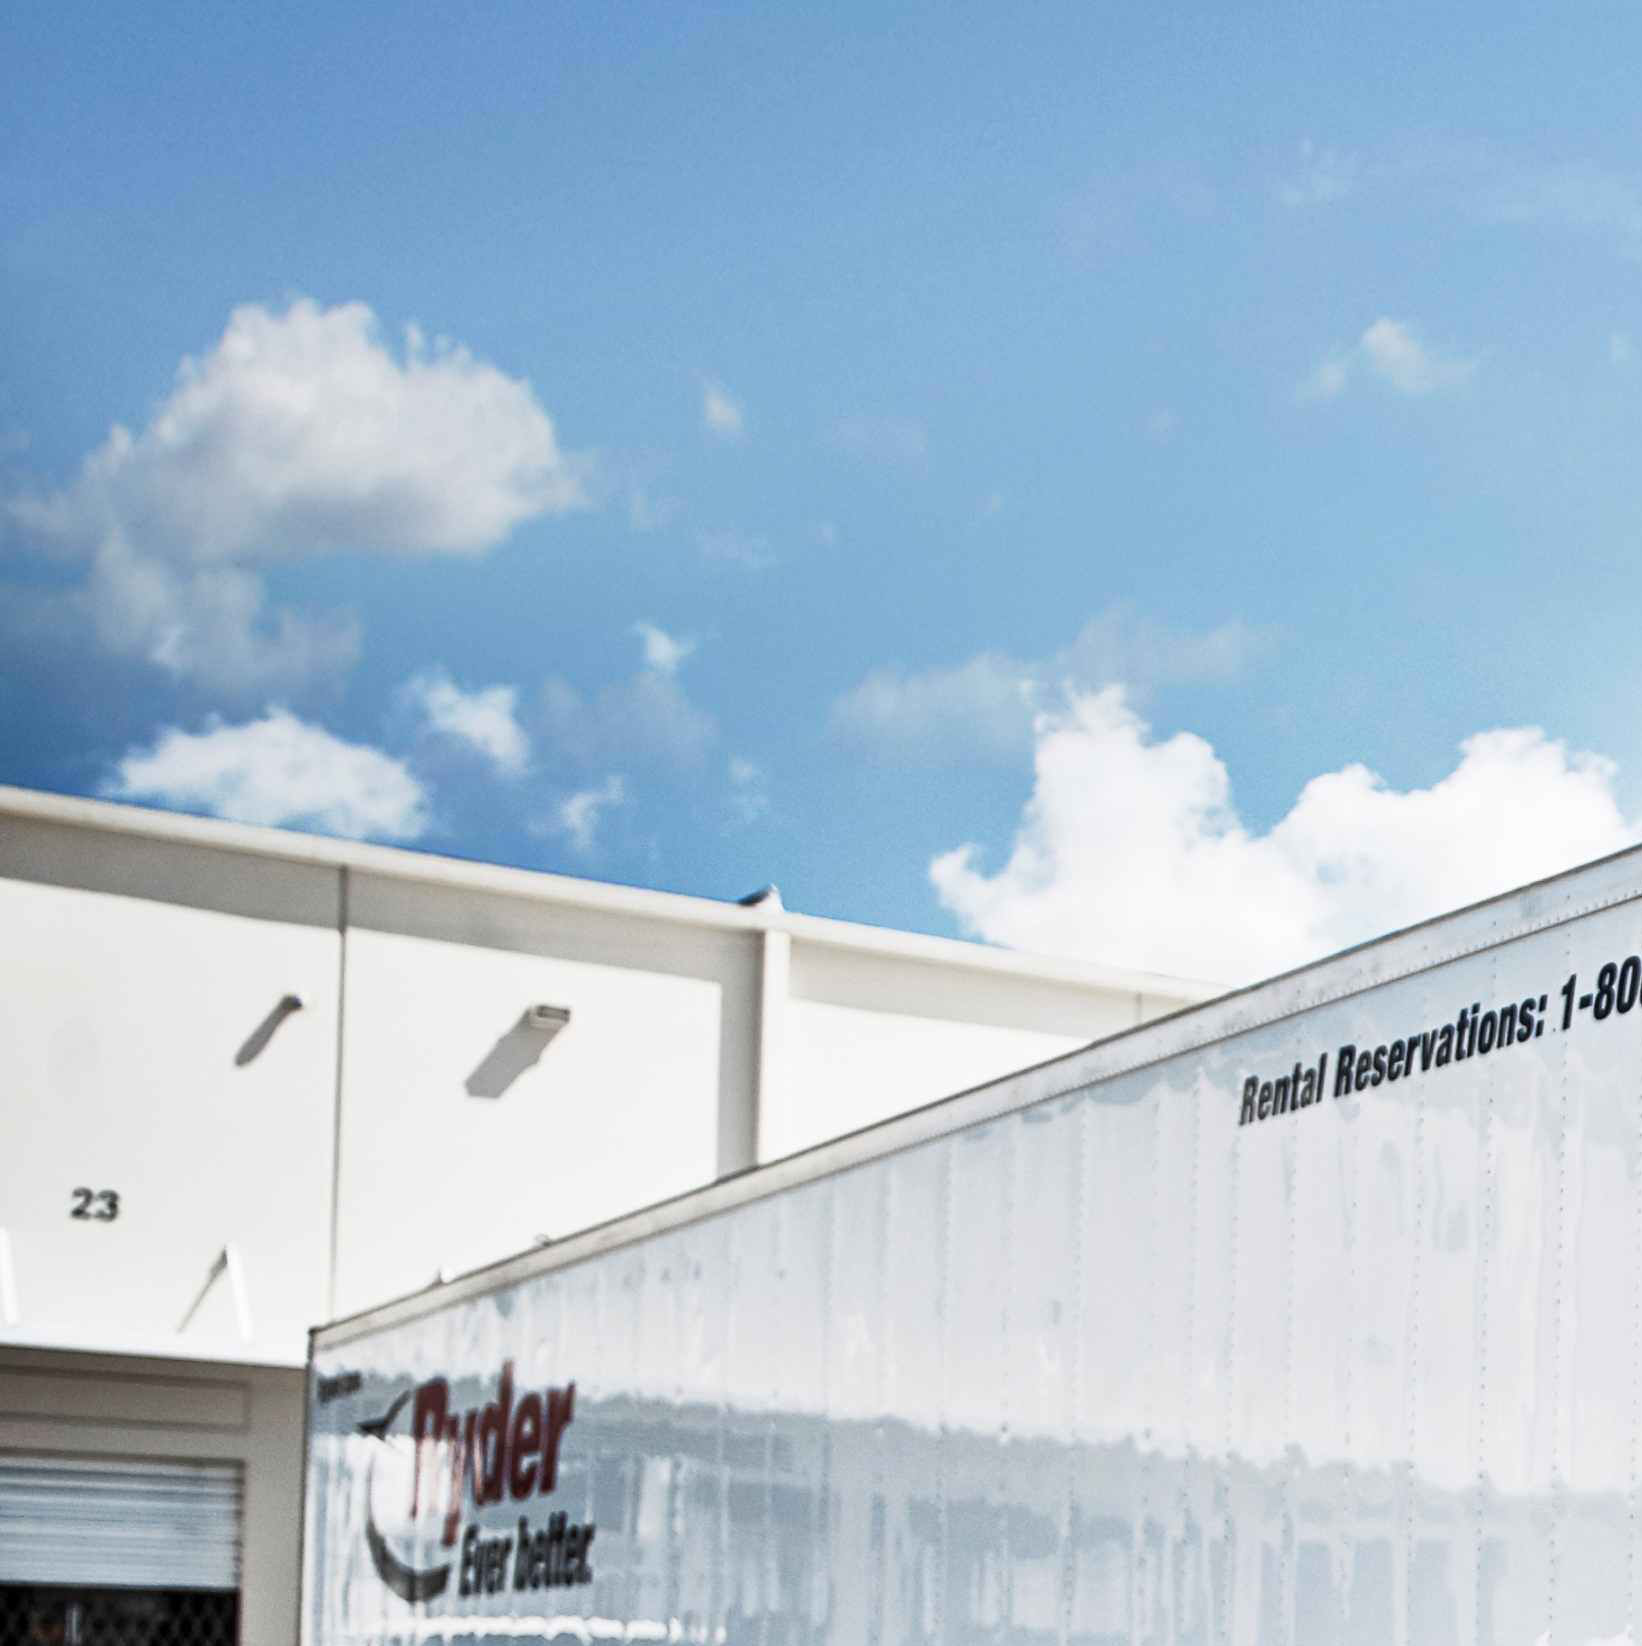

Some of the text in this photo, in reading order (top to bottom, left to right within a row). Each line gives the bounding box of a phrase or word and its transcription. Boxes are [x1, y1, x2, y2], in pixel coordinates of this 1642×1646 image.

[1238, 1061, 1327, 1126] Rental
[1333, 993, 1549, 1098] Reservations:
[69, 1187, 120, 1221] 23
[410, 1358, 577, 1549] Ryder
[459, 1523, 513, 1597] Ever
